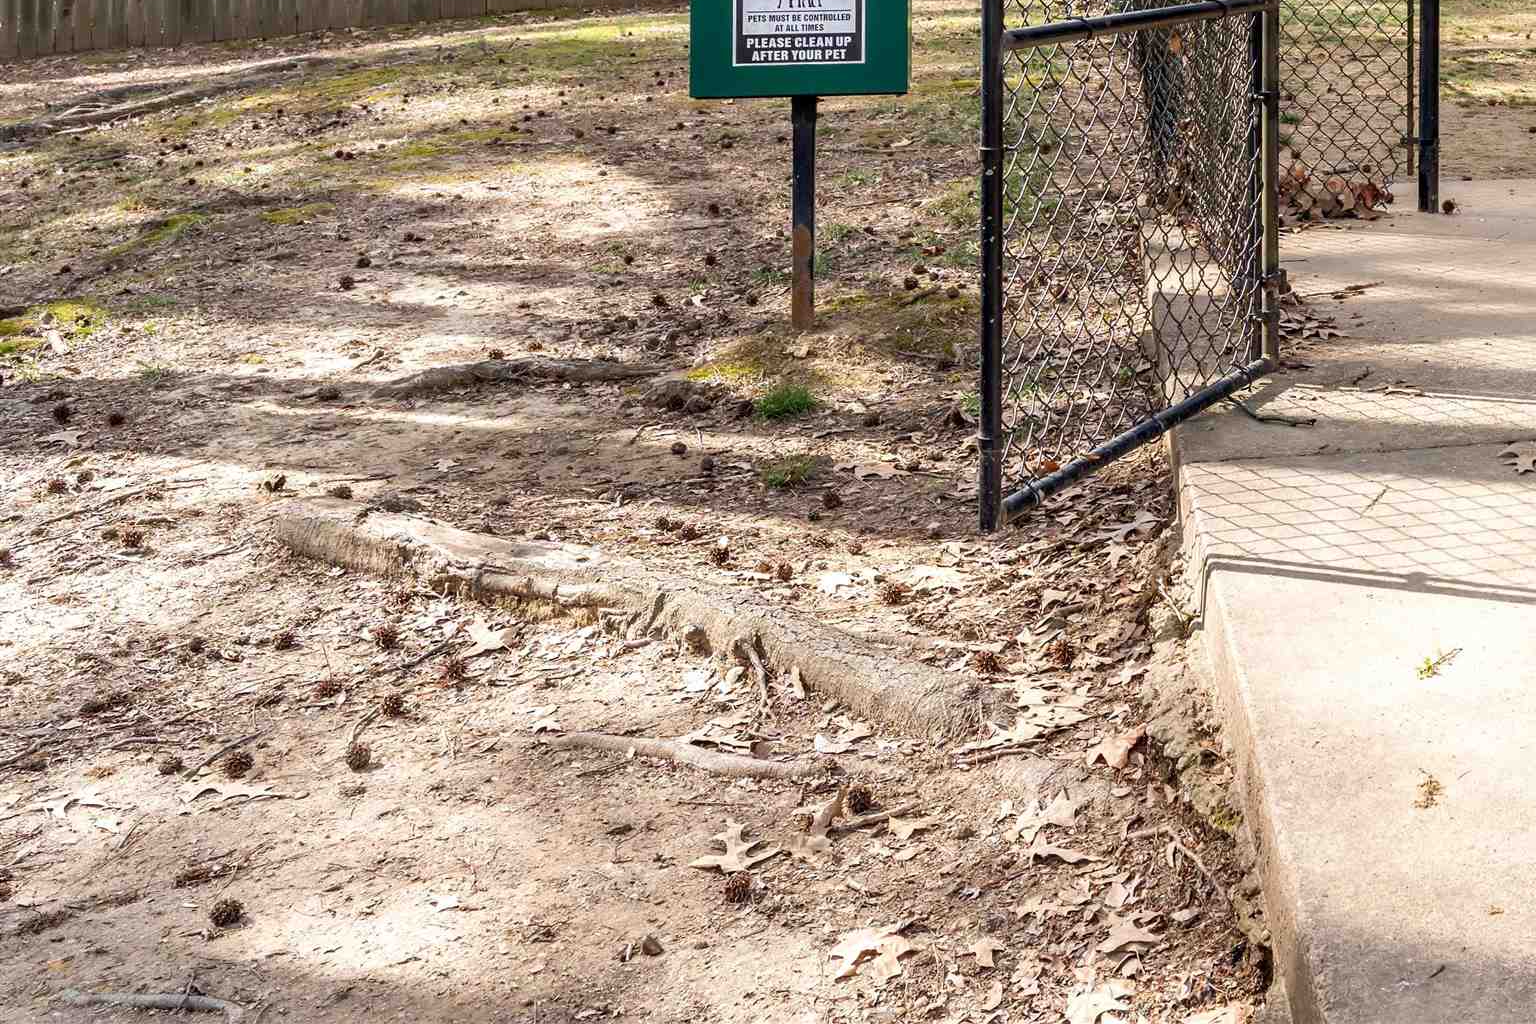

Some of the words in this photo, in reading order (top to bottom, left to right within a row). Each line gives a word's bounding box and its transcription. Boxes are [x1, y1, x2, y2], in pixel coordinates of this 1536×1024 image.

[747, 14, 767, 23] PETS
[768, 14, 790, 23] MUST
[791, 14, 802, 22] BE
[803, 13, 851, 22] CONTROLLED
[774, 24, 784, 33] AT
[785, 24, 800, 32] ALL
[801, 23, 825, 32] TIMES
[746, 37, 792, 49] PLEASE
[794, 36, 833, 48] CLEAN
[835, 36, 852, 47] UP
[751, 50, 789, 62] AFTER
[791, 49, 823, 61] YOUR
[825, 49, 847, 60] PET
